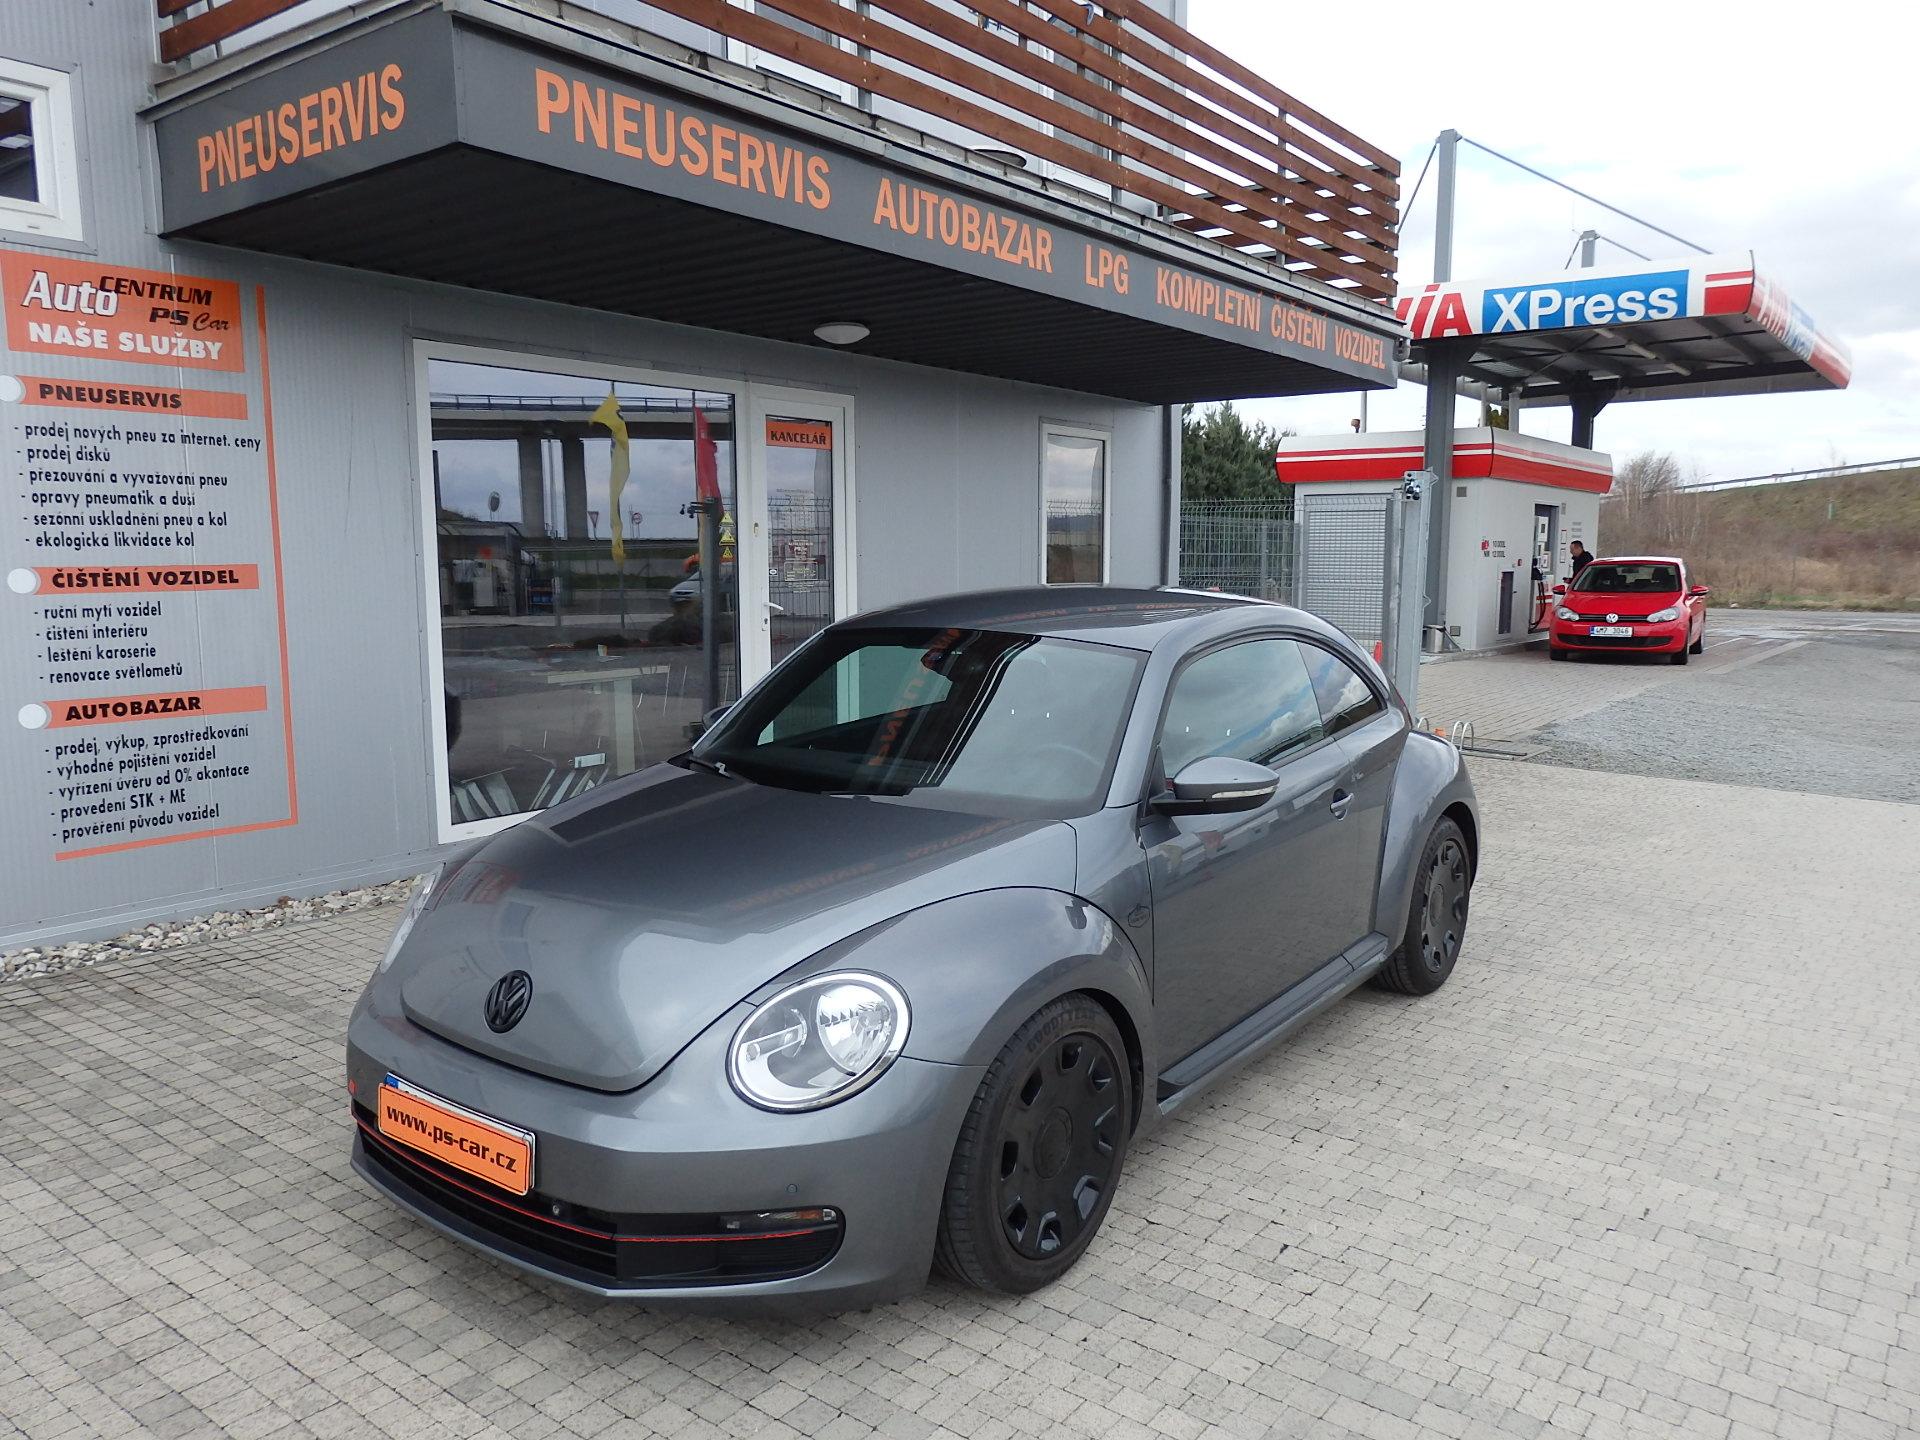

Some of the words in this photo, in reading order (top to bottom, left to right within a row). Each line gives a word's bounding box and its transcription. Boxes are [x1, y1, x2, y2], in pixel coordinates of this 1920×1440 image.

[197, 63, 406, 193] PNEUSERVIS
[535, 67, 831, 211] PNEUSERVIS
[873, 177, 1053, 274] AUTOBAZAR
[1084, 243, 1129, 295] LPG
[1156, 267, 1263, 332] KOMPLETNÍ
[1335, 325, 1386, 370] VOZIDEL
[21, 270, 118, 317] Auto
[100, 275, 213, 306] CENTRUM
[149, 307, 189, 326] PS
[192, 312, 229, 331] Car
[1492, 287, 1679, 334] XPress
[29, 320, 109, 349] NAŠE
[119, 331, 222, 360] SLUŽBY
[39, 383, 182, 409] PNEUSERVIS
[25, 423, 69, 442] prodej
[74, 425, 121, 443] nových
[126, 430, 157, 445] pneu
[162, 432, 176, 443] za
[180, 429, 231, 447] internet.
[234, 437, 261, 452] ceny
[770, 430, 826, 445] KANCELÁŘ
[27, 447, 71, 464] prodej
[29, 469, 104, 486] přezouvání
[110, 474, 117, 483] a
[122, 472, 195, 488] vyvažování
[199, 476, 228, 489] pneu
[31, 492, 80, 507] opravy
[85, 490, 154, 507] pneumatik
[159, 495, 167, 505] a
[33, 511, 84, 526] sezónní
[89, 511, 159, 526] uskladnění
[163, 514, 194, 529] pneu
[197, 516, 205, 526] a
[209, 511, 228, 526] kol
[35, 532, 109, 550] ekologická
[114, 532, 172, 547] likvidace
[176, 532, 195, 547] kol
[52, 568, 139, 588] ČIŠTĚNÍ
[147, 570, 239, 586] VOZIDEL
[44, 603, 77, 620] ruční
[82, 603, 112, 621] mytí
[117, 600, 162, 617] vozidel
[46, 625, 89, 641] čištění
[93, 623, 148, 639] interiéru
[48, 646, 92, 662] leštění
[96, 643, 157, 660] karoserie
[50, 669, 110, 683] renovace
[115, 663, 183, 681] světlometů
[65, 697, 202, 721] AUTOBAZAR
[153, 724, 249, 747] zprostředkování
[57, 755, 114, 780] výhodné
[118, 750, 170, 772] pojištění
[174, 745, 216, 763] vozidel
[59, 777, 112, 800] vyřízení
[116, 772, 152, 790] úvěru
[156, 772, 171, 787] od
[175, 767, 193, 783] 0%
[196, 764, 250, 781] akontace
[61, 800, 126, 822] provedení
[130, 792, 154, 809] STK
[170, 788, 186, 803] ME
[62, 820, 125, 843] prověření
[129, 813, 174, 834] původu
[178, 803, 220, 823] vozidel
[386, 1105, 517, 1173] www.ps-car.cz
